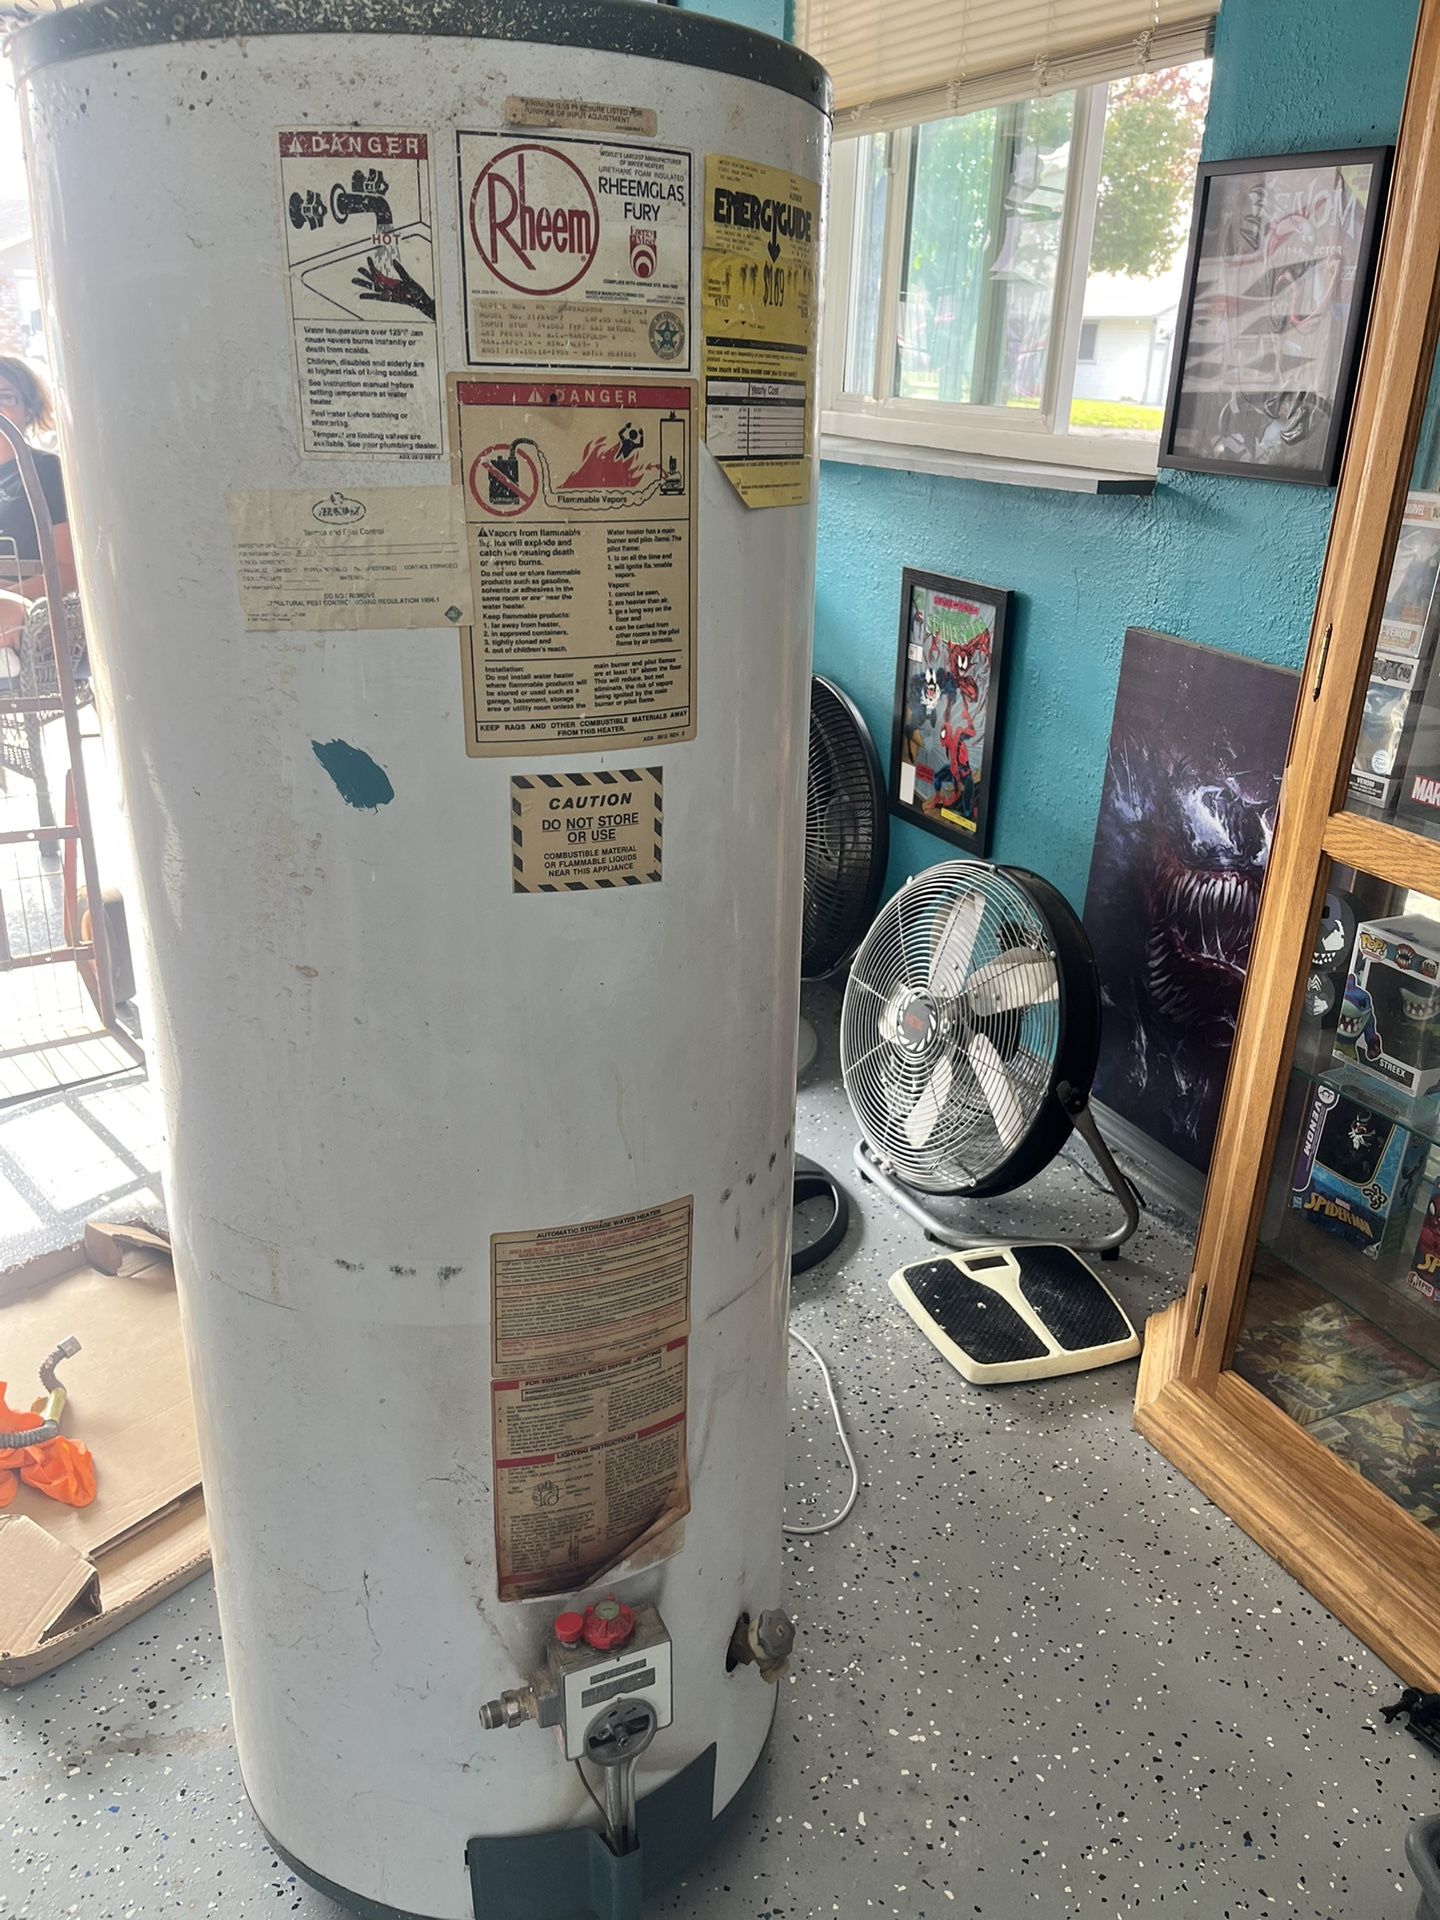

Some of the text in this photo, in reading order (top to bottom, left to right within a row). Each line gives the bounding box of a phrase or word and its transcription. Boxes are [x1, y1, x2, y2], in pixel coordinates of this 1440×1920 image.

[588, 113, 630, 122] ADJUSTMENT
[312, 138, 418, 154] DANGER
[645, 156, 682, 165] MANUFACTURER
[599, 166, 632, 176] URETHANE
[654, 172, 684, 182] INSULATED
[598, 176, 684, 202] RHEEMGLAS
[487, 154, 591, 270] Rheem
[624, 202, 661, 222] FURY
[372, 234, 402, 246] HOT
[556, 390, 637, 403] DANGER
[750, 386, 778, 396] Yearly Cost
[558, 496, 627, 504] Flammable Vapors
[514, 578, 531, 587] such
[541, 578, 571, 587] gasoline,
[378, 597, 419, 605] REGULATION
[580, 717, 628, 726] COMBUSTIBLE
[632, 712, 668, 722] MATERIALS
[598, 726, 625, 734] HEATER.
[1357, 777, 1375, 787] VENOM
[549, 792, 632, 810] CAUTION
[542, 812, 638, 831] DO NOT STORE
[568, 829, 616, 843] OR USE
[544, 846, 637, 860] COMBUSTIBLE MATERIAL
[544, 854, 636, 869] OR FLAMMABLE LIQUIDS
[548, 863, 633, 878] NEAR THIS APPLIANCE
[1360, 932, 1387, 954] POP!
[1380, 1059, 1406, 1078] STREEX
[1304, 1101, 1322, 1156] VENOM
[1304, 1192, 1374, 1239] SPIDER-MAN
[537, 1210, 661, 1238] AUTOMATIC STORAGE WATER HEATER
